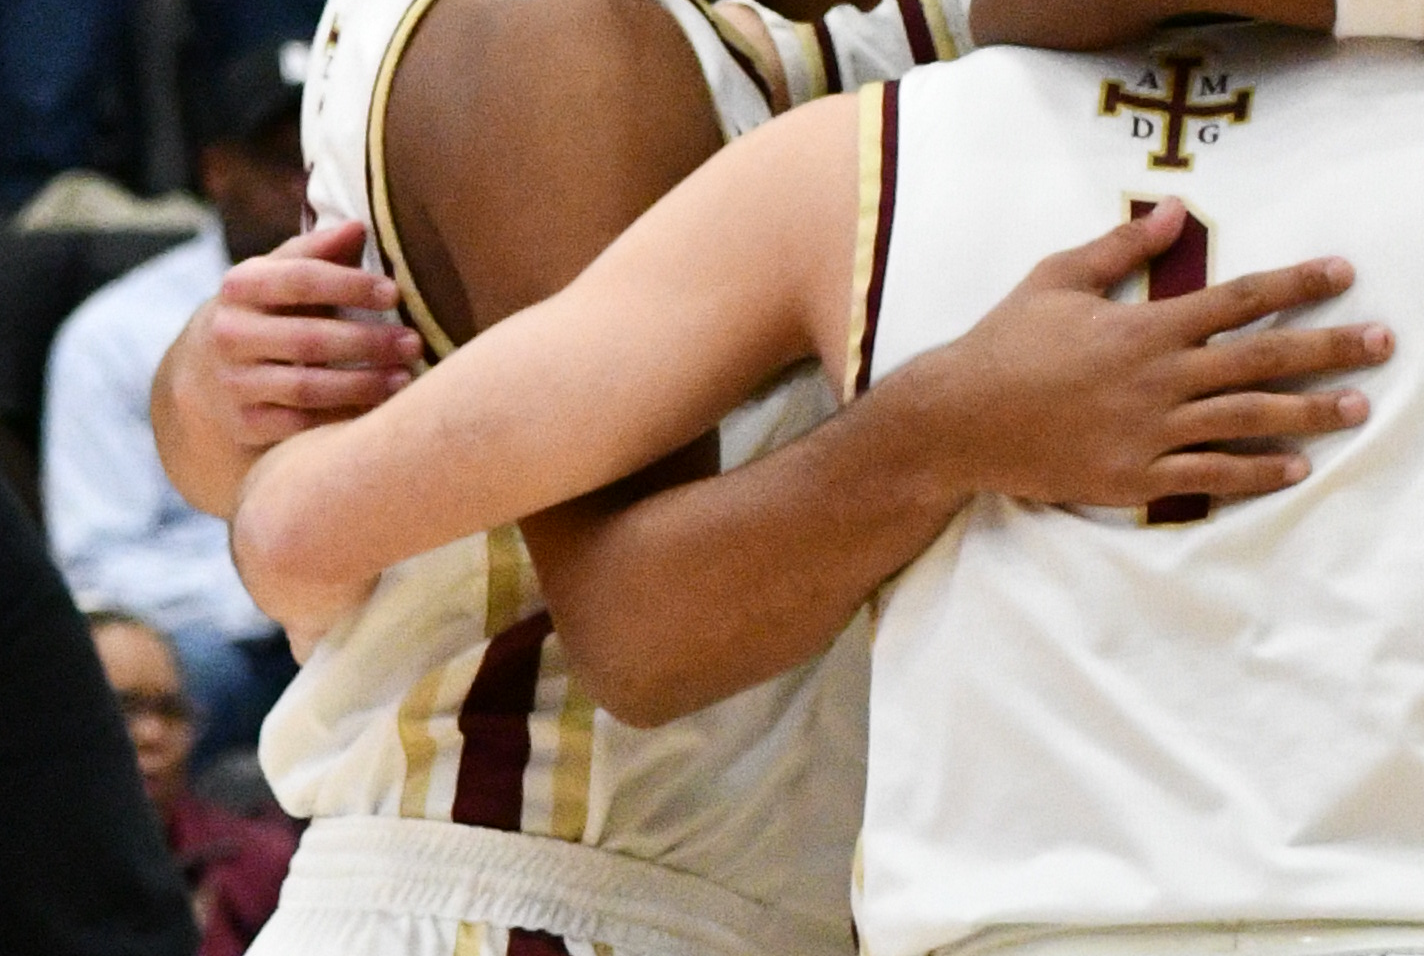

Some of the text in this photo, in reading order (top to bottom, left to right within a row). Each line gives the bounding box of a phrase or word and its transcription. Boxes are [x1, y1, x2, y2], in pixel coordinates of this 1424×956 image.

[1136, 69, 1230, 96] A M
[1132, 116, 1219, 144] D G
